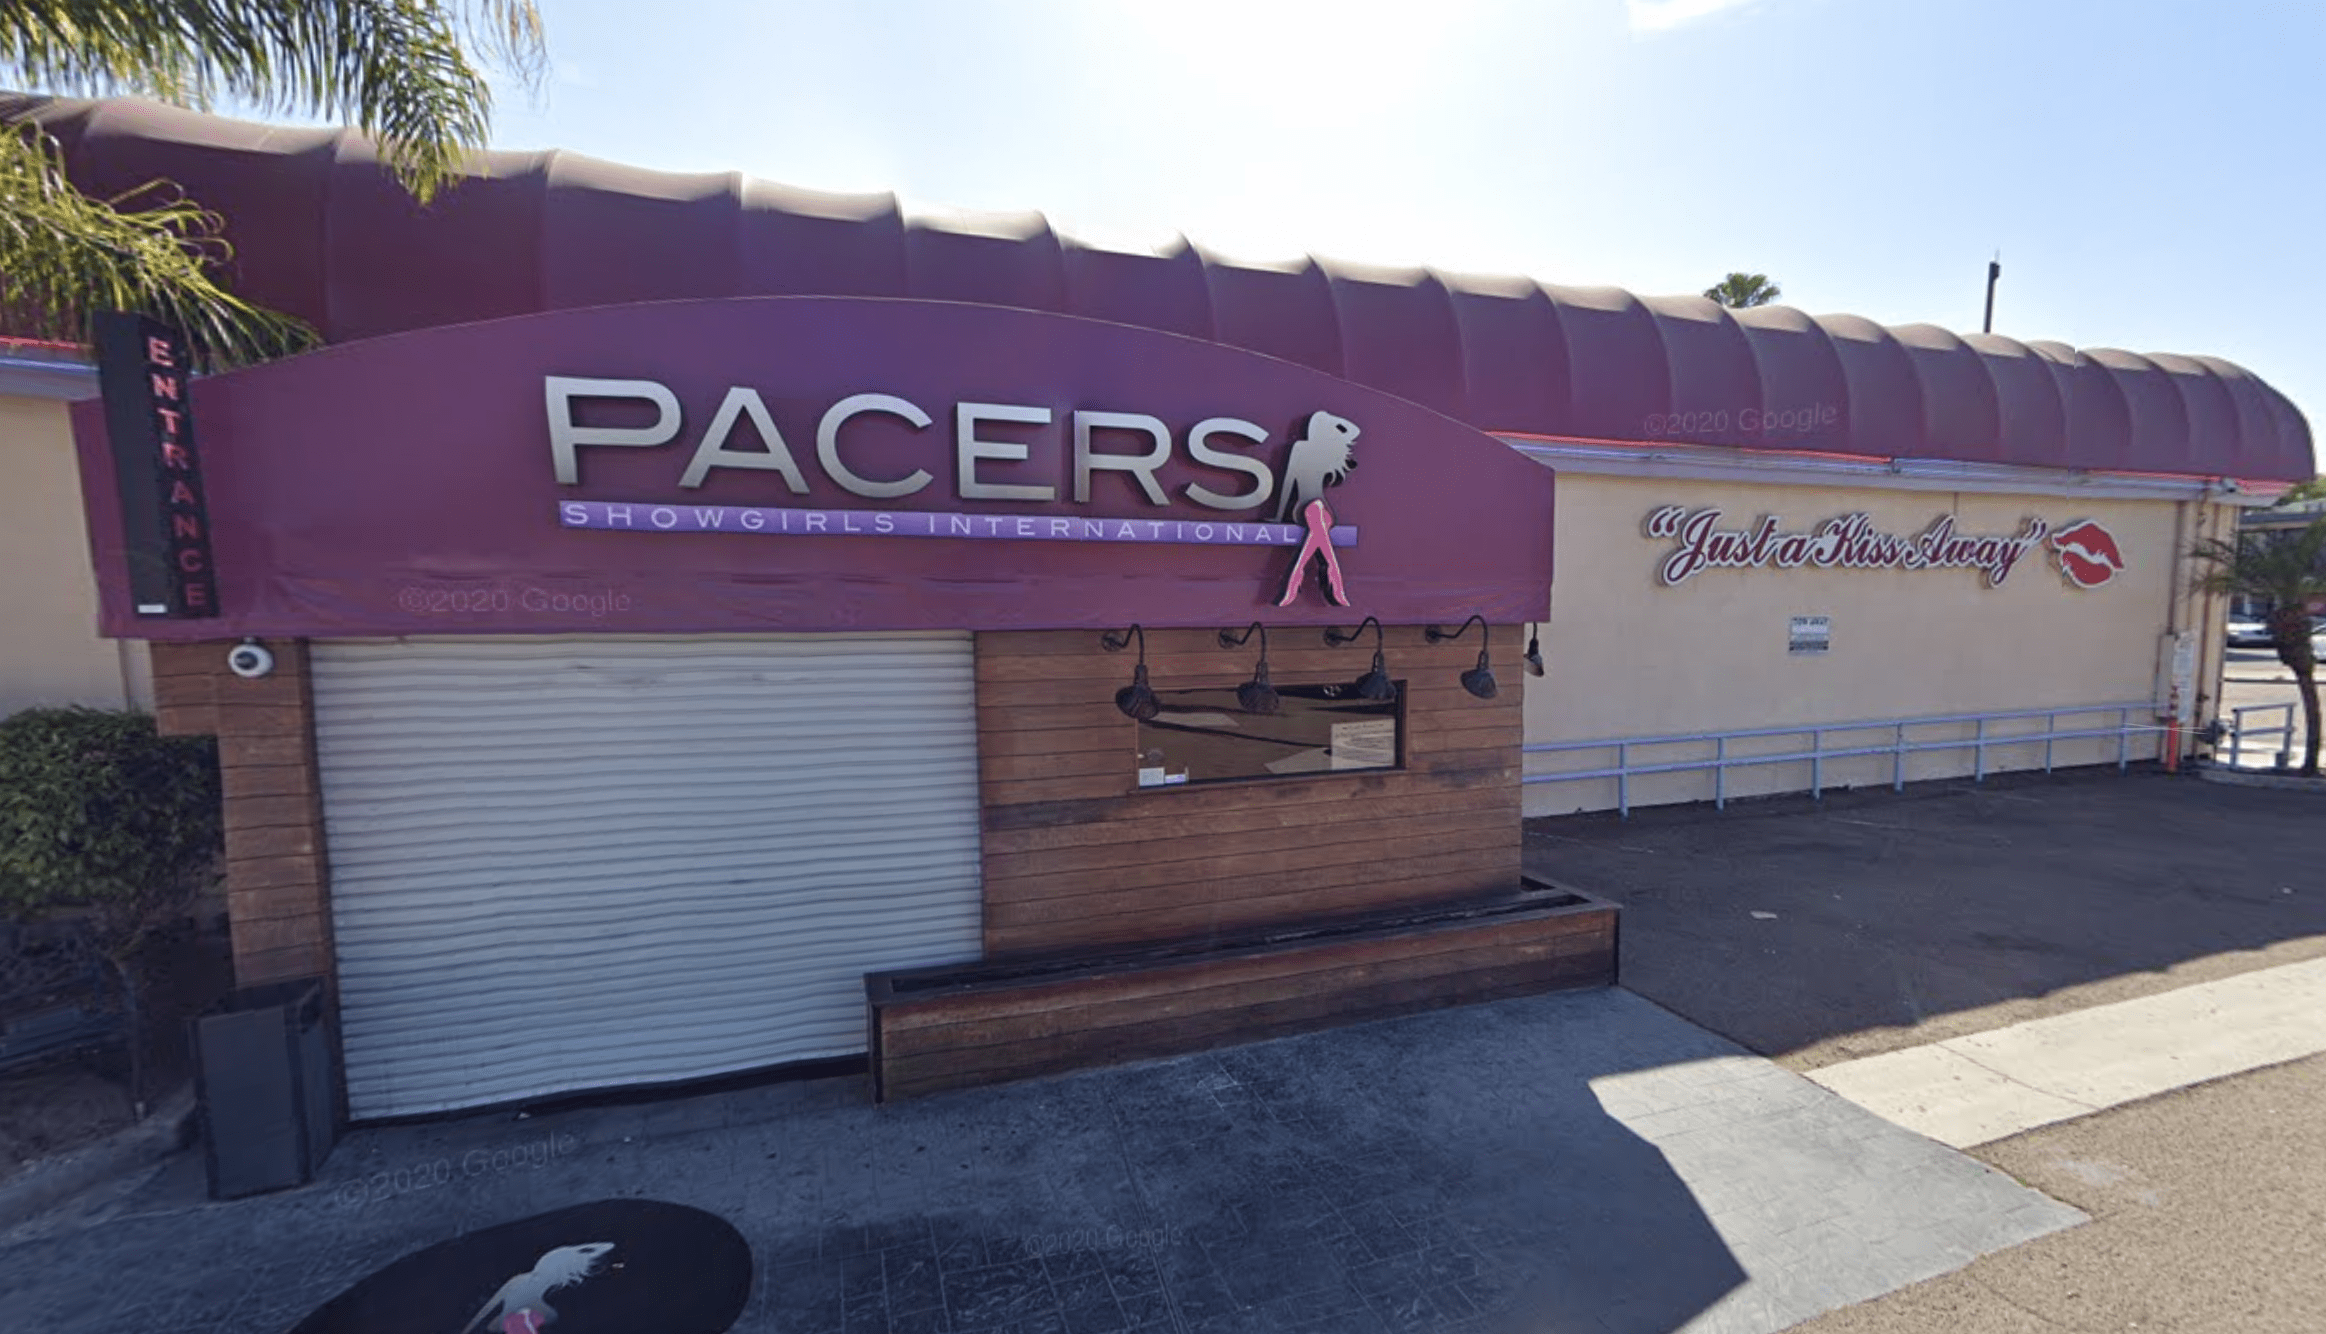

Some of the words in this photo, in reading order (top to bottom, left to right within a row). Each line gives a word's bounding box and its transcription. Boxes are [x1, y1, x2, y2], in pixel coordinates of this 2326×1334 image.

[147, 335, 207, 607] ENTRANCE
[544, 374, 1275, 511] PACERS
[563, 503, 895, 534] SHOWGIRLS
[929, 515, 1297, 544] INTERNATIONAL
[1777, 535, 1817, 568] a
[1812, 513, 1906, 568] Kiss
